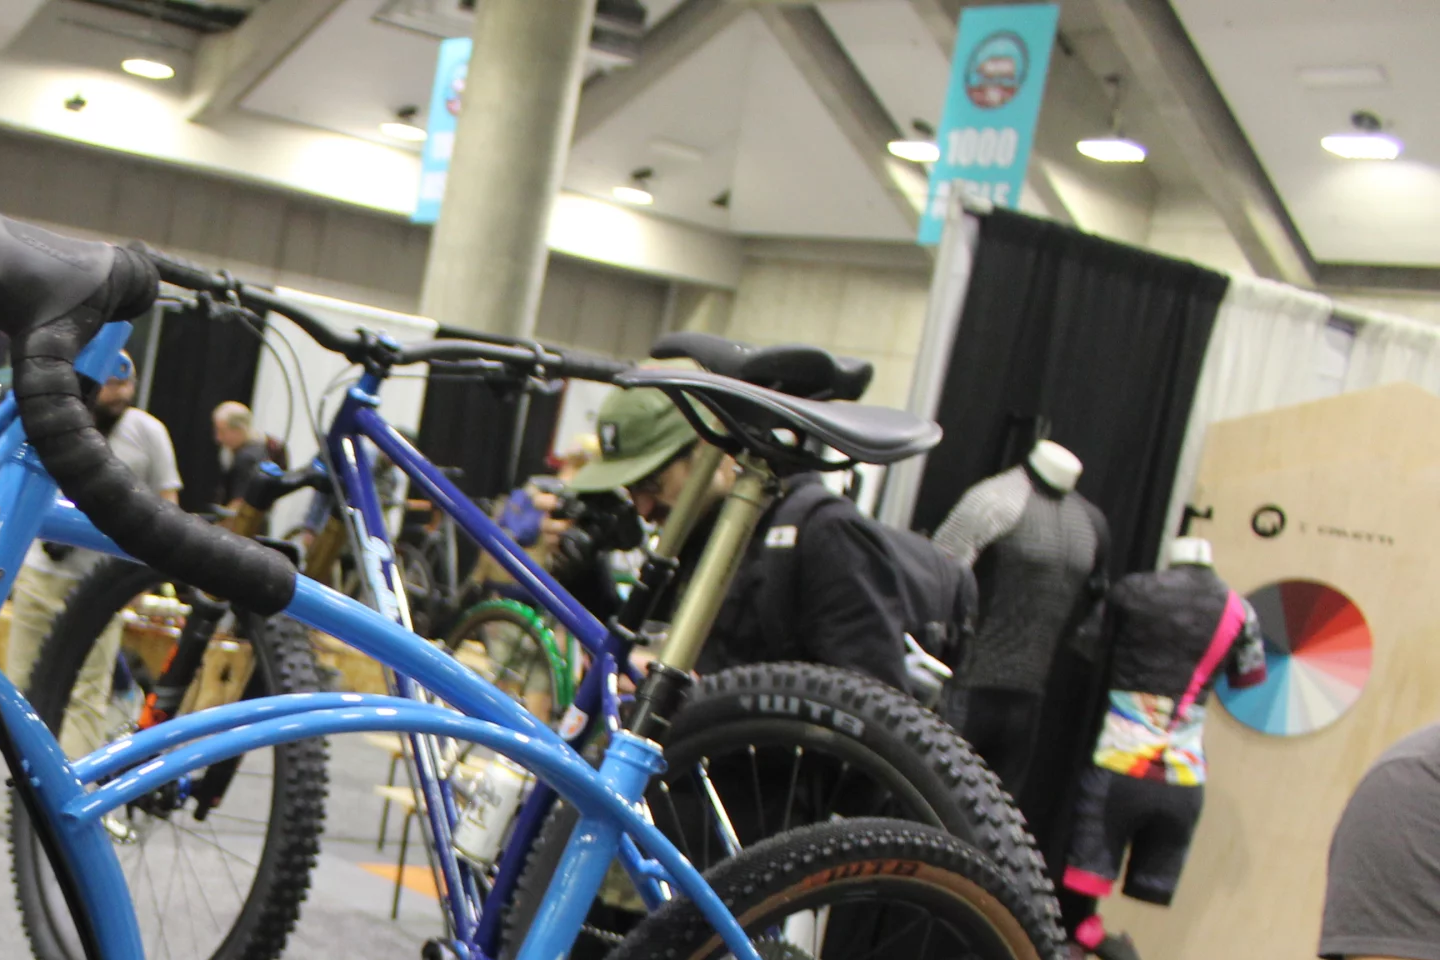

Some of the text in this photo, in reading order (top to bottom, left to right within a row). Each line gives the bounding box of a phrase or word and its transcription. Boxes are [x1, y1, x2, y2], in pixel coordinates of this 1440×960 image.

[947, 126, 1019, 167] 1000
[758, 692, 866, 738] WTB
[827, 860, 919, 883] WTB
